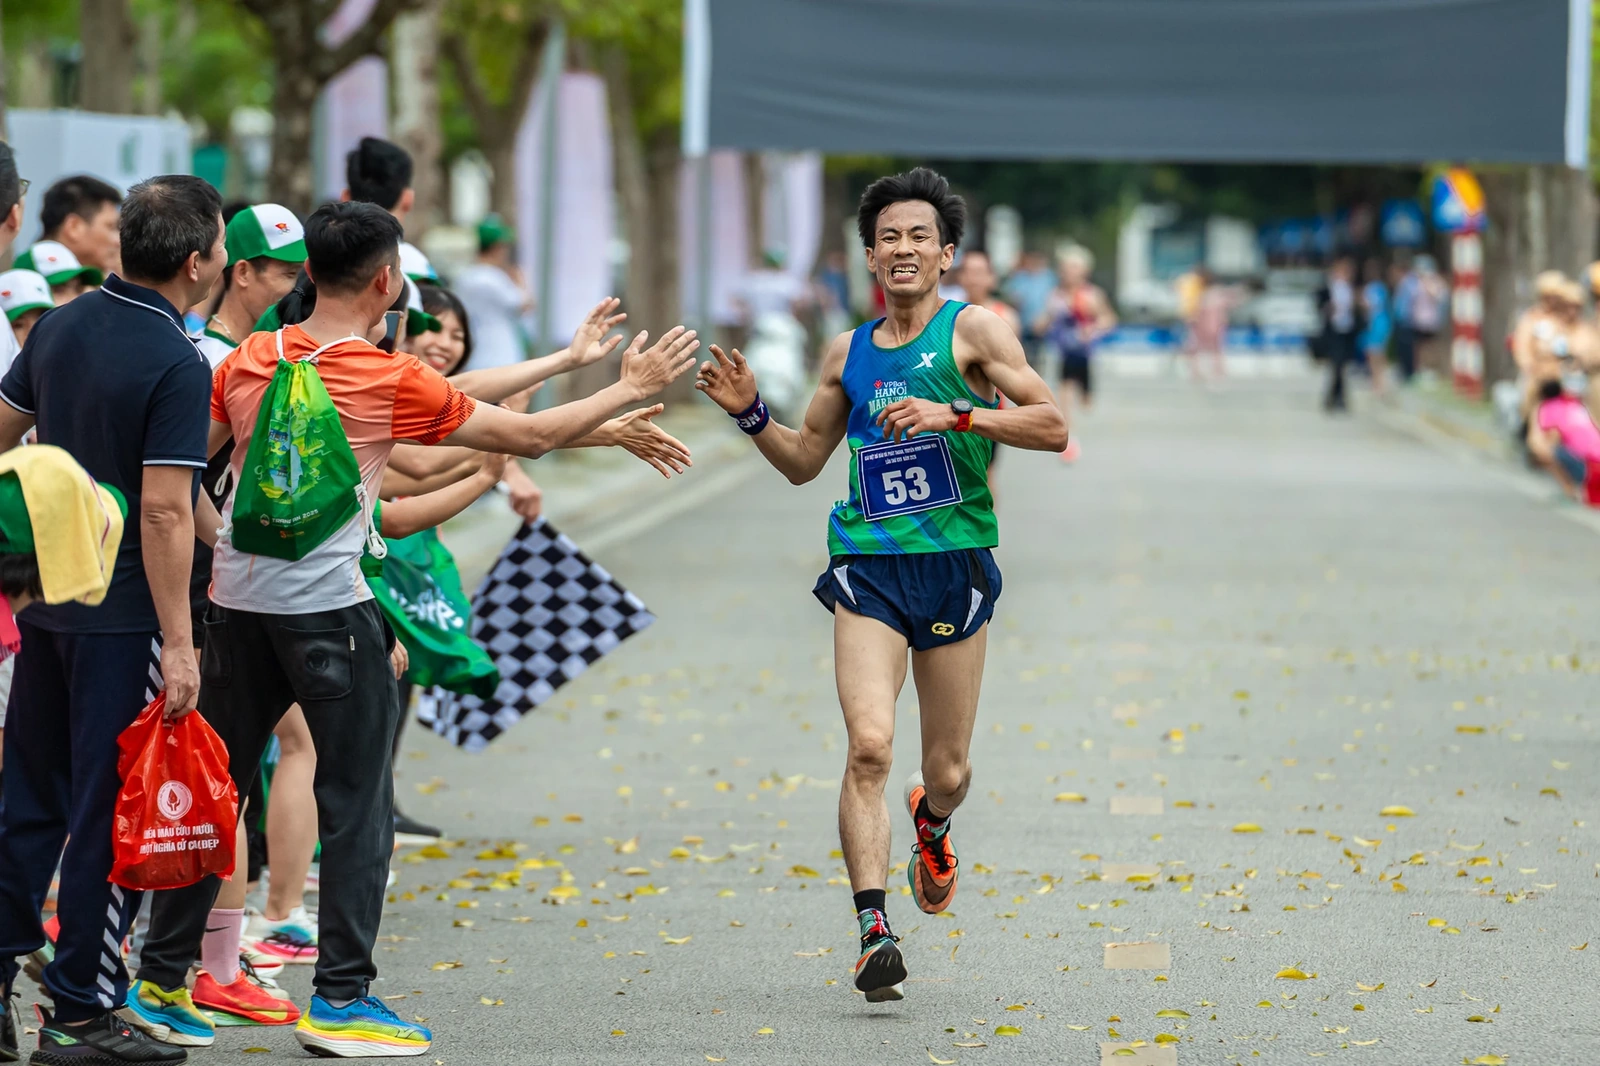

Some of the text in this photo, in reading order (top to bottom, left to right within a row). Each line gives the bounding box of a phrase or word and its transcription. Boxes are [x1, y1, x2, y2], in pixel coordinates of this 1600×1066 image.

[875, 386, 907, 398] HANOI
[882, 466, 931, 506] 53
[157, 826, 175, 838] MÁU
[201, 839, 220, 851] ĐẸP
